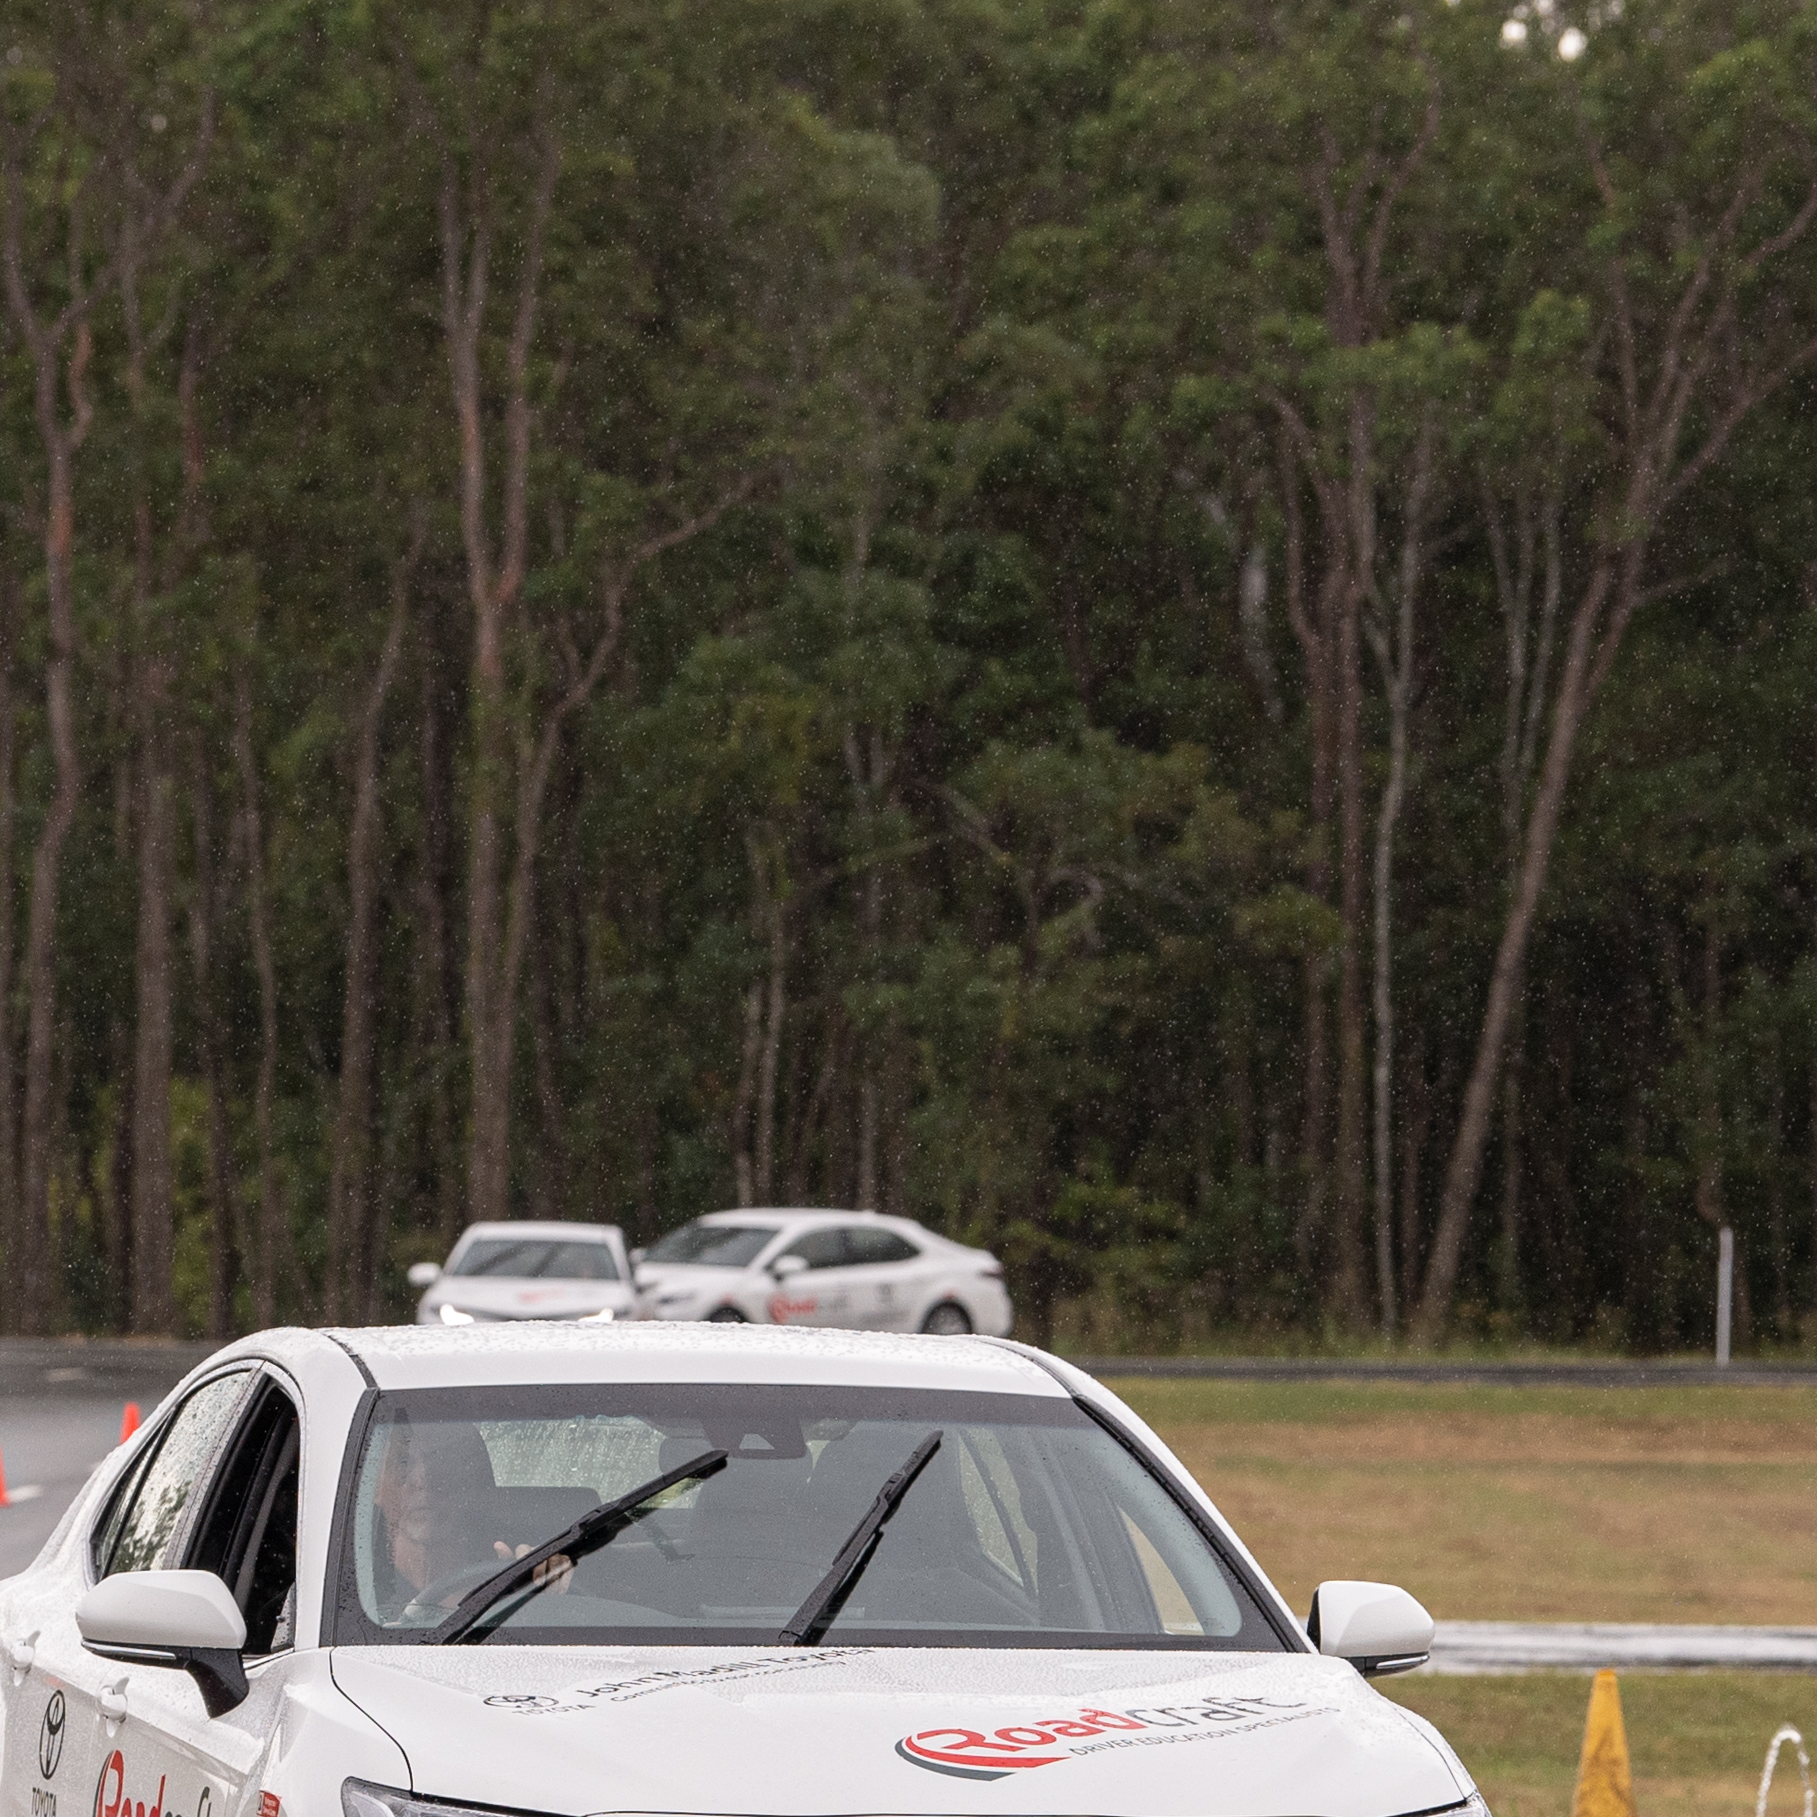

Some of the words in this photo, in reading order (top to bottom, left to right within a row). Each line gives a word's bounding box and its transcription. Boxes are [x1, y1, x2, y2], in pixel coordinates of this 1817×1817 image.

[576, 1676, 662, 1697] John
[512, 1704, 596, 1715] TOYOTA
[903, 1696, 1306, 1768] Roadcraft
[1069, 1729, 1136, 1756] DRIVER
[1137, 1717, 1239, 1747] EDUCATION
[1237, 1706, 1341, 1733] SPECIALISTS
